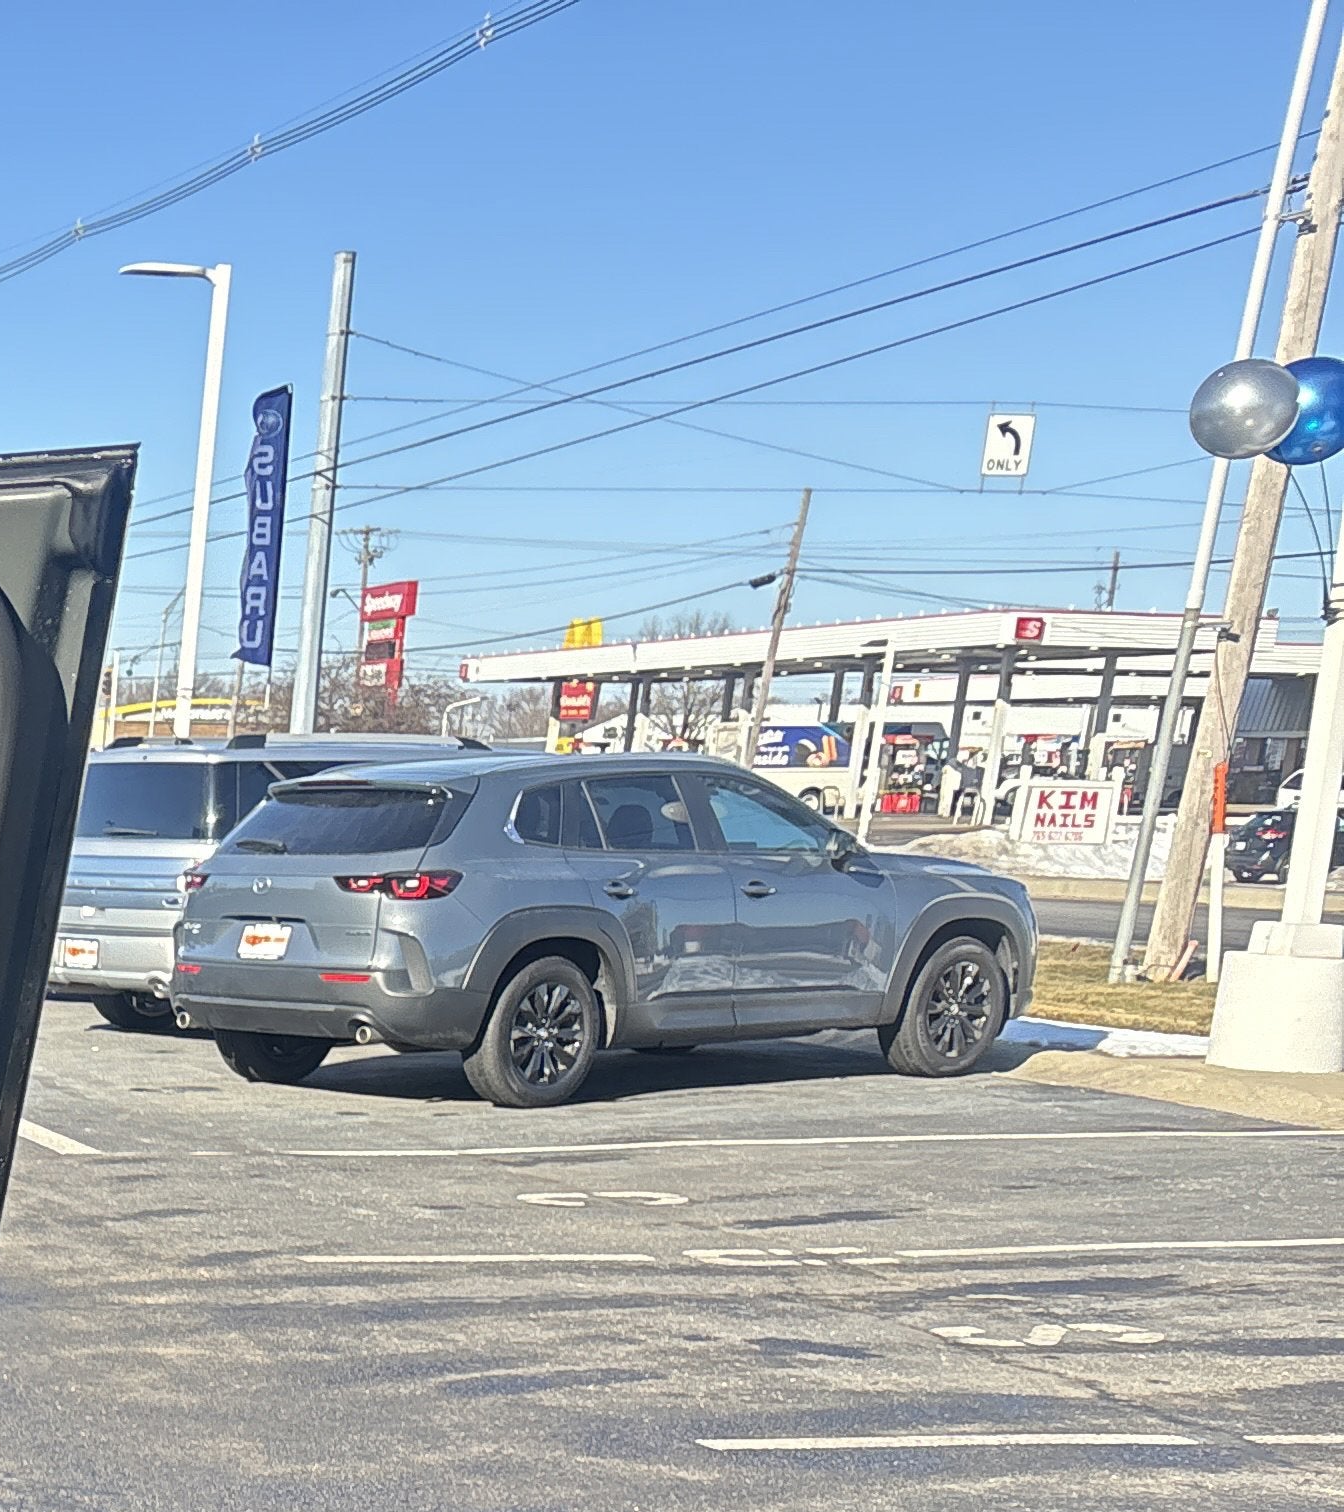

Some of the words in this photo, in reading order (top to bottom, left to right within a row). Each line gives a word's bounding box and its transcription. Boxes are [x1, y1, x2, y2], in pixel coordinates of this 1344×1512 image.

[986, 458, 1023, 472] ONLY
[1037, 789, 1099, 811] KIM
[1034, 812, 1096, 829] NAILS
